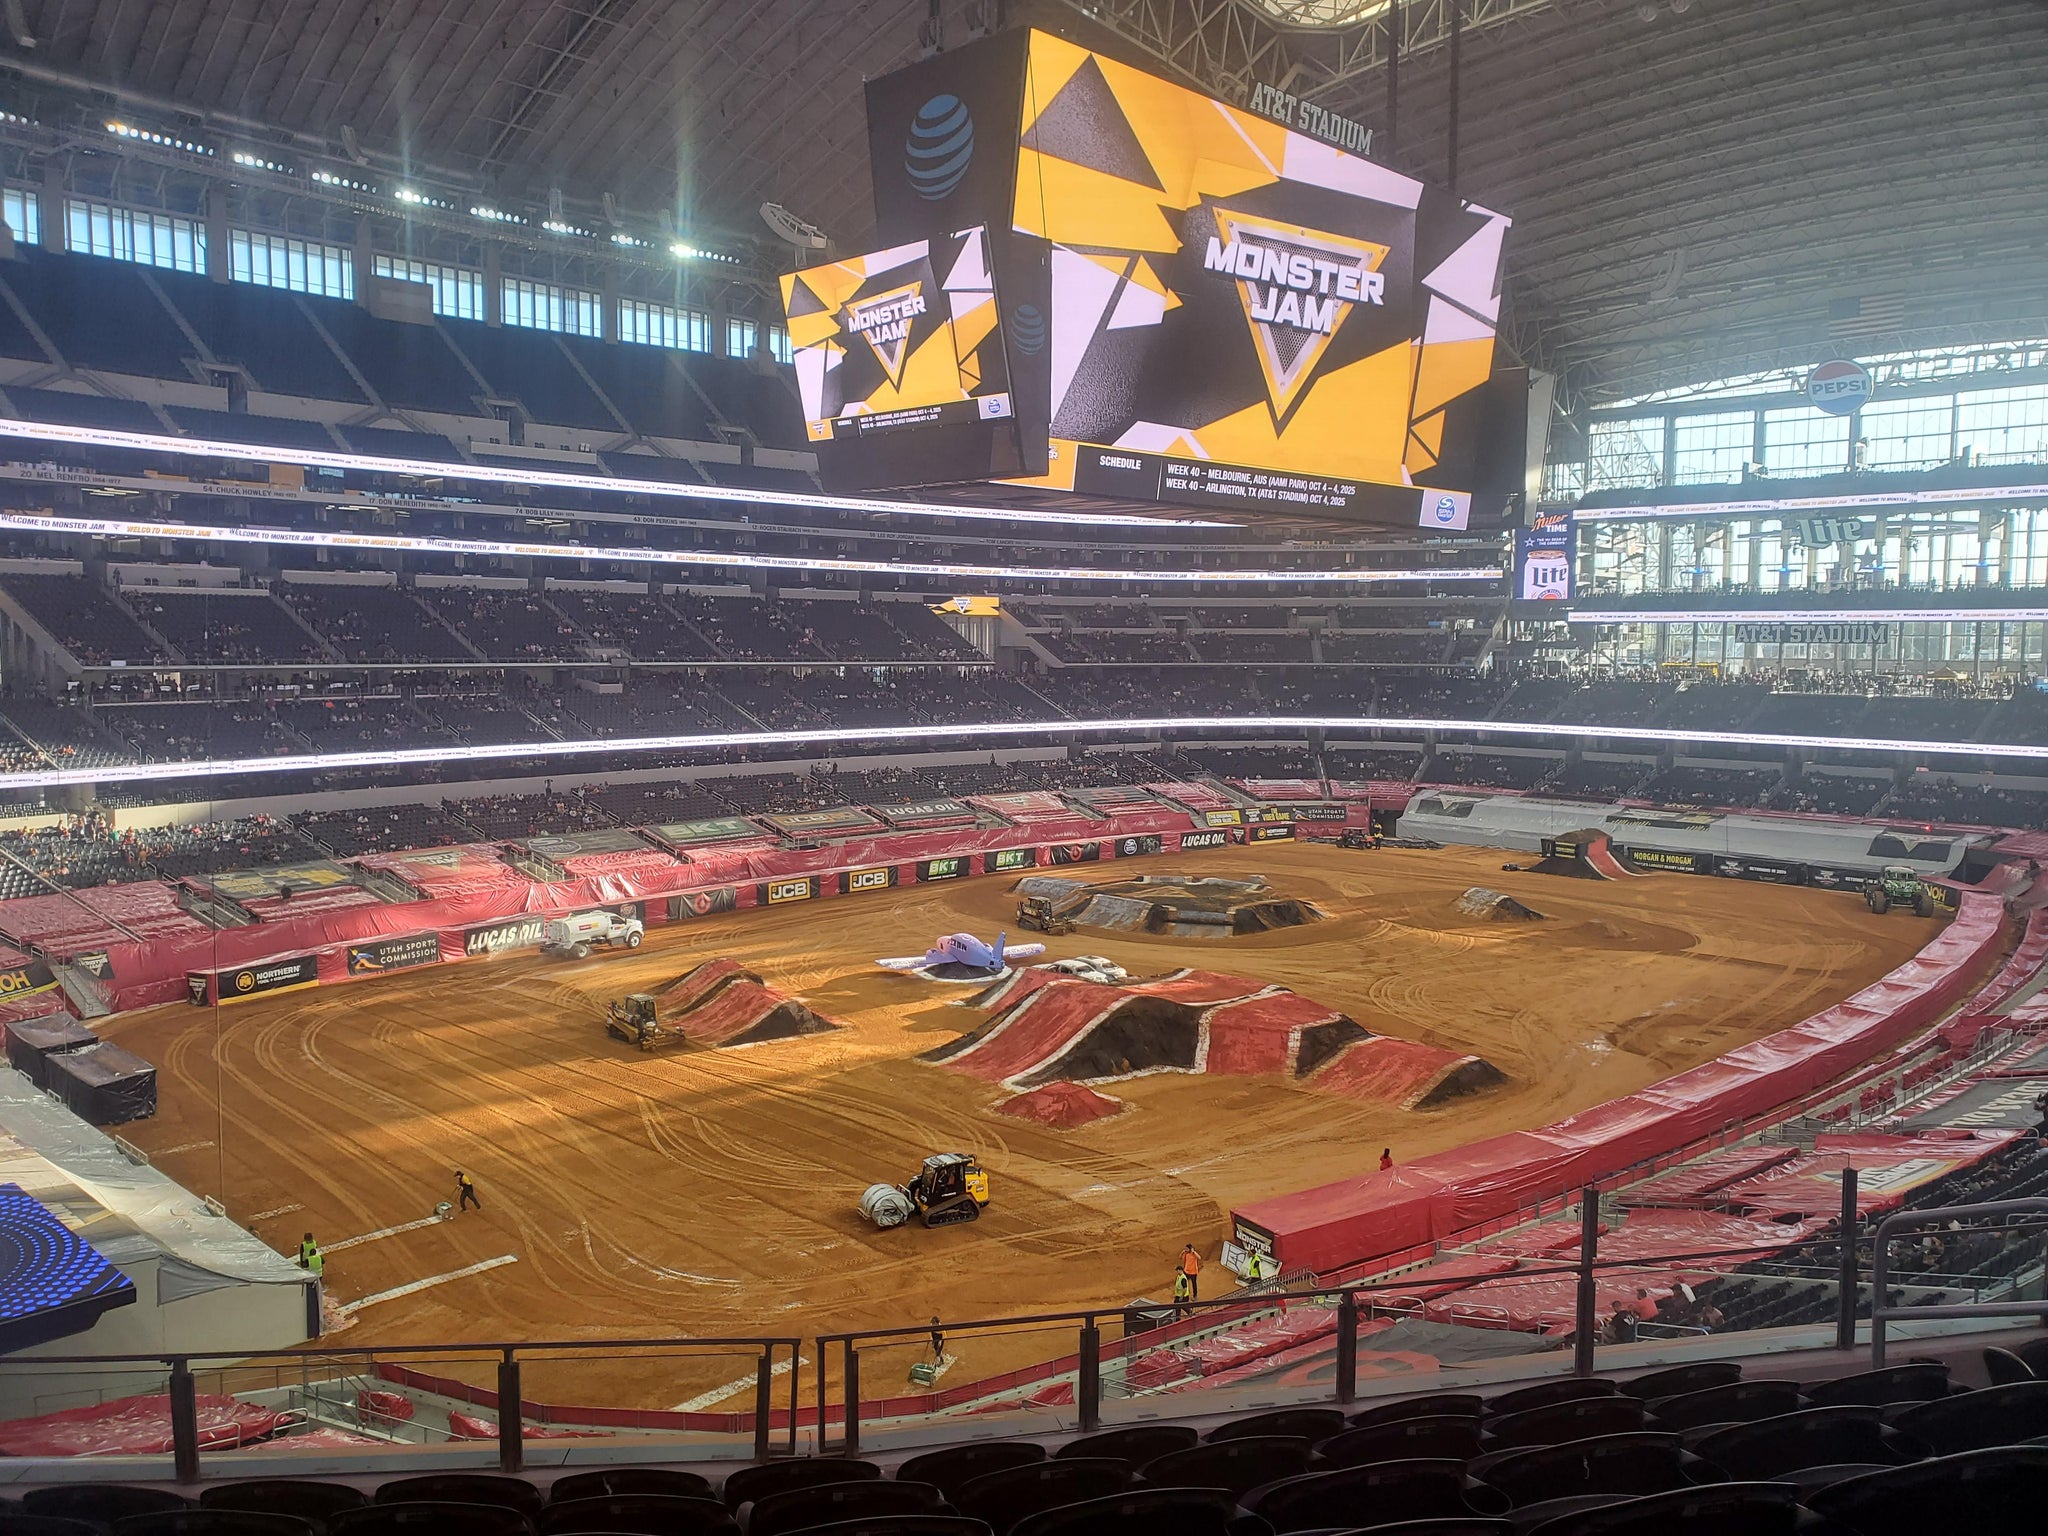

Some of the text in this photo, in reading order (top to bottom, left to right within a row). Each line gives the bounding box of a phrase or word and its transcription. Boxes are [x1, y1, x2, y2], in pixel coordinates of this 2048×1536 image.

[1250, 82, 1373, 155] AT&T STADIUM
[1204, 237, 1384, 306] MONSTER
[848, 296, 927, 333] MONSTER
[1251, 287, 1335, 335] JAM
[869, 318, 907, 345] JAM
[1812, 379, 1867, 395] PEPSI
[1100, 455, 1142, 471] SCHEDULE
[56, 473, 90, 483] RENFRO
[1168, 463, 1356, 495] WEEK 40 MELBOURNE, AUS (AAMI PARK) OCT 4 4, 2025
[216, 487, 241, 495] CHUCK
[242, 488, 272, 497] HOWLEY
[1166, 477, 1346, 507] WEEK 40 ARLINGTON, TX (AT&T STADIUM) OCT 4, 2025
[394, 499, 427, 508] MEREDITH
[1, 514, 38, 526] WELCOME
[52, 521, 88, 529] MONSTER
[229, 528, 261, 538] WELCOME
[271, 533, 300, 541] MONSTER
[1797, 518, 1862, 548] Lite
[426, 539, 454, 548] WELCOME
[1532, 567, 1567, 588] Lite
[1736, 625, 1886, 643] AT&T STADIUM
[886, 805, 933, 815] LUCAS
[1182, 832, 1226, 847] LUCAS OIL
[997, 851, 1024, 866] BKT
[1633, 852, 1659, 861] MORGAN
[1666, 855, 1692, 865] MORGAN
[929, 860, 958, 875] BKT
[852, 871, 886, 888] JCB
[772, 881, 807, 899] JCB
[468, 921, 542, 951] LUCAS OIL
[380, 939, 437, 955] UTAH SPORTS
[381, 948, 437, 964] COMMISSION
[257, 965, 301, 980] NORTHERN
[1236, 1230, 1272, 1254] MONSTER
